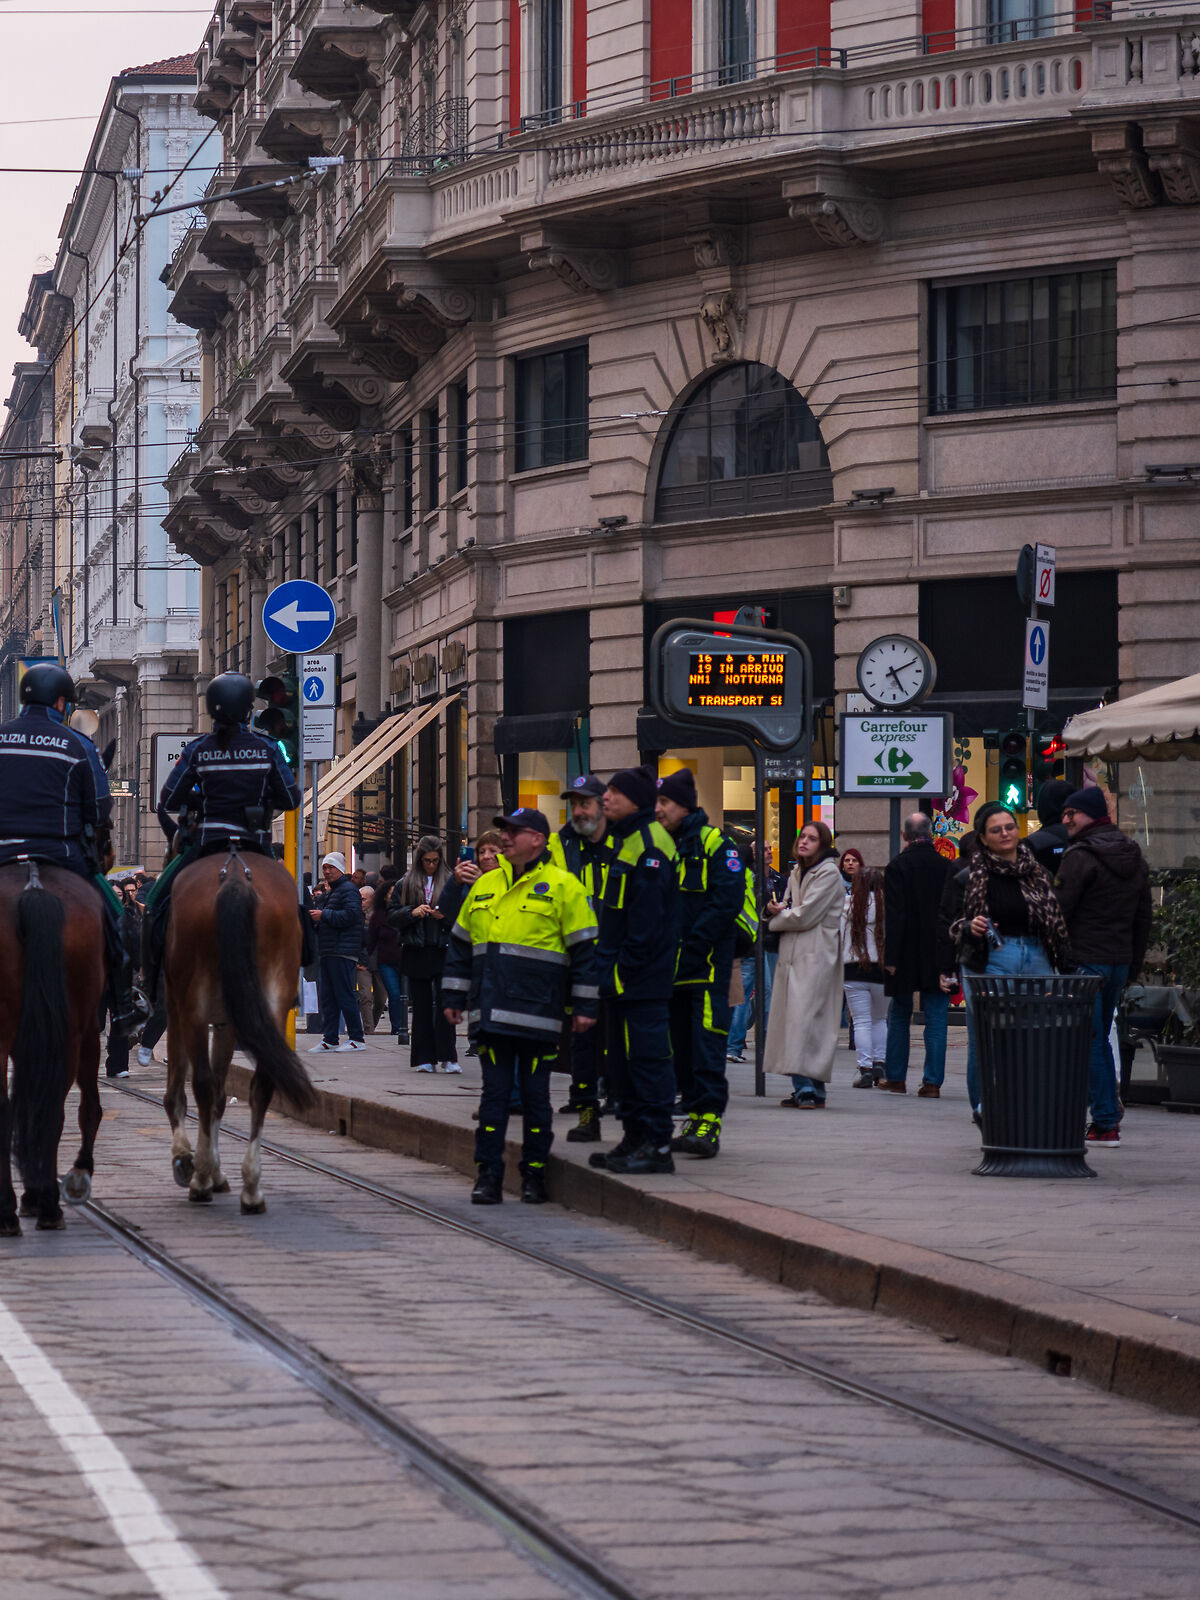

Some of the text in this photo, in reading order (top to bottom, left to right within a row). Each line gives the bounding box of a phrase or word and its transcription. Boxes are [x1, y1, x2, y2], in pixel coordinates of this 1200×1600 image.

[698, 653, 713, 663] 16
[747, 653, 756, 663] 6
[761, 653, 784, 663] MIN
[698, 663, 784, 674] 19 IN ARRIVO
[689, 674, 784, 685] NM1 NOTTURNA
[699, 694, 764, 706] TRANSPORT
[860, 720, 928, 732] Carrefour
[29, 734, 69, 749] LOCALE
[870, 733, 917, 746] express
[198, 749, 268, 761] POLIZIA LOCALE
